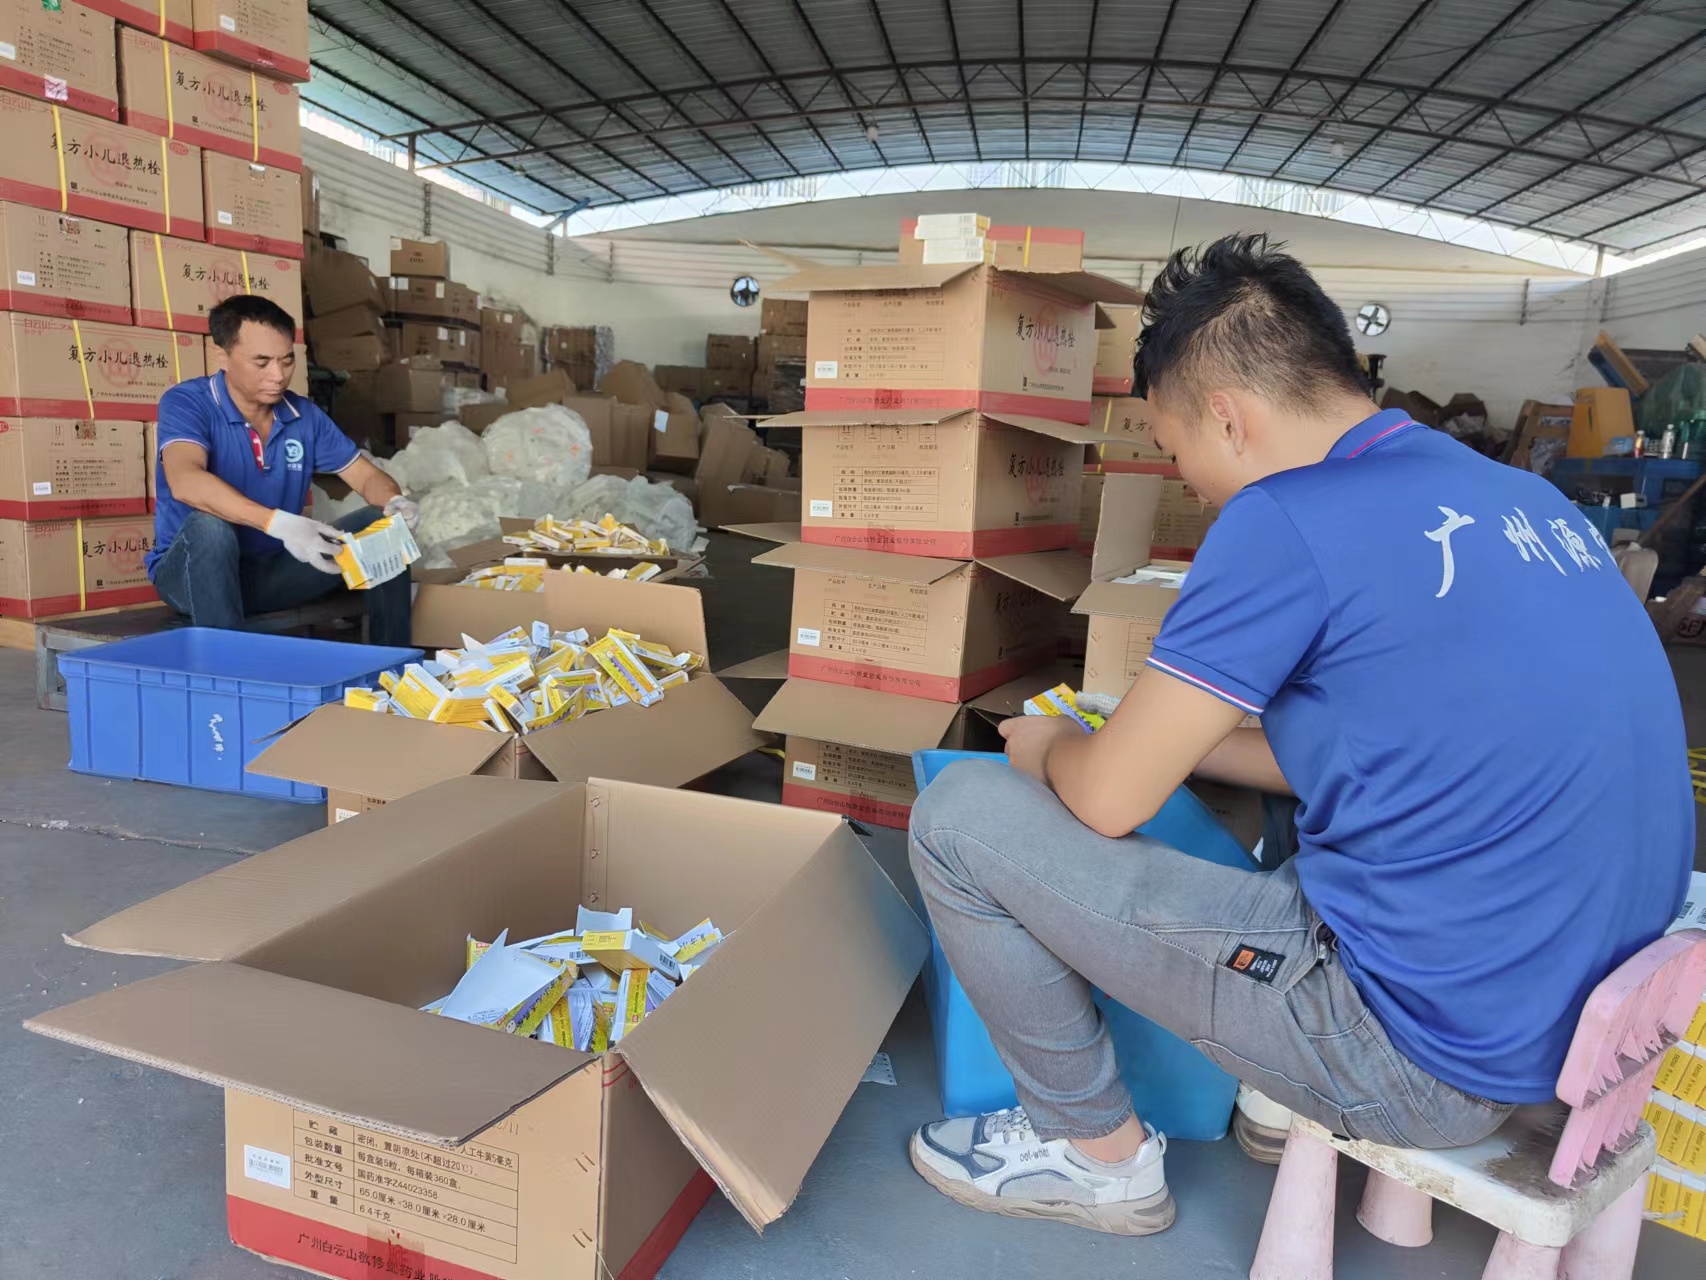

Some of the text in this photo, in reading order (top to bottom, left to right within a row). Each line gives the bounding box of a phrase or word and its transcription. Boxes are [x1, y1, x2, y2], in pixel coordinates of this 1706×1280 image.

[68, 344, 169, 369] 复方小儿退热栓
[1122, 417, 1153, 433] 复方
[82, 536, 157, 558] 复方小儿退
[304, 1136, 343, 1156] 包装数量
[304, 1153, 343, 1173] 批准文号
[304, 1170, 344, 1190] 外型尺寸
[356, 1168, 439, 1200] 国药准字Z44023358
[358, 1204, 392, 1223] 6.4千克
